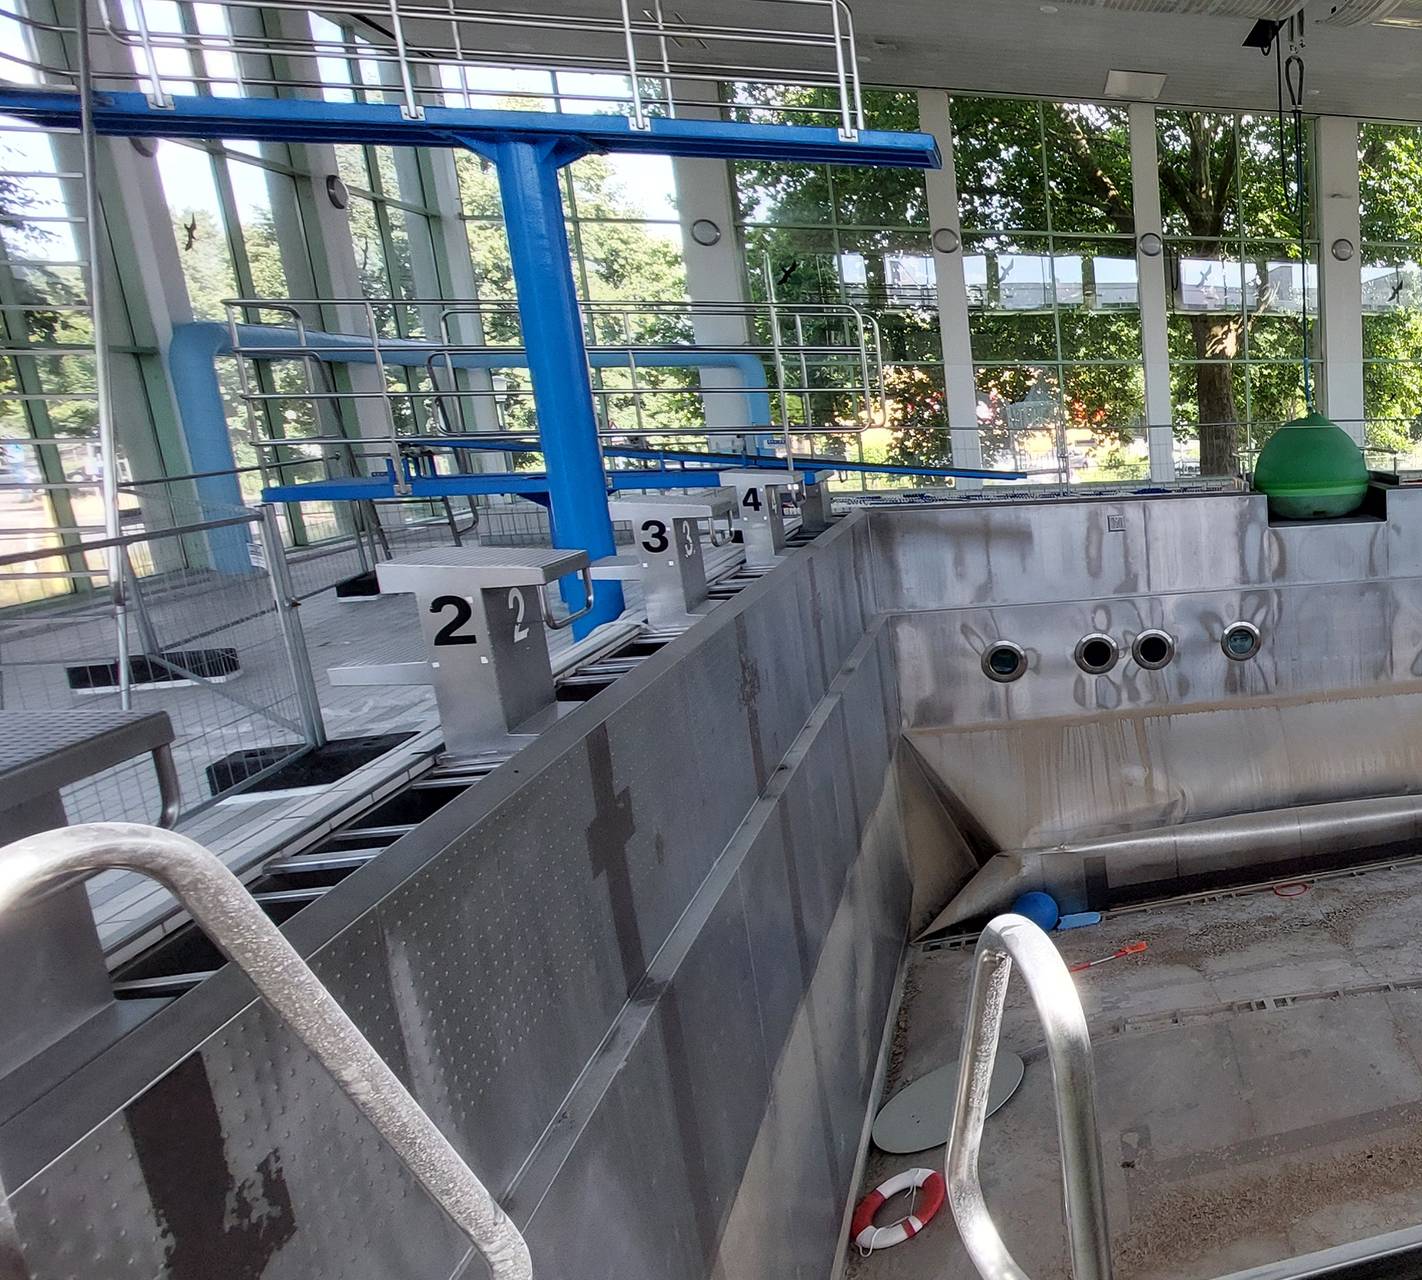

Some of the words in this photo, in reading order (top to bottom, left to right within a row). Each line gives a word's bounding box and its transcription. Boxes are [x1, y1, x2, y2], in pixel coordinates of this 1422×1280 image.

[742, 487, 762, 512] 4
[641, 519, 669, 553] 3
[682, 520, 694, 557] 3
[429, 595, 477, 646] 2
[508, 587, 530, 643] 2
